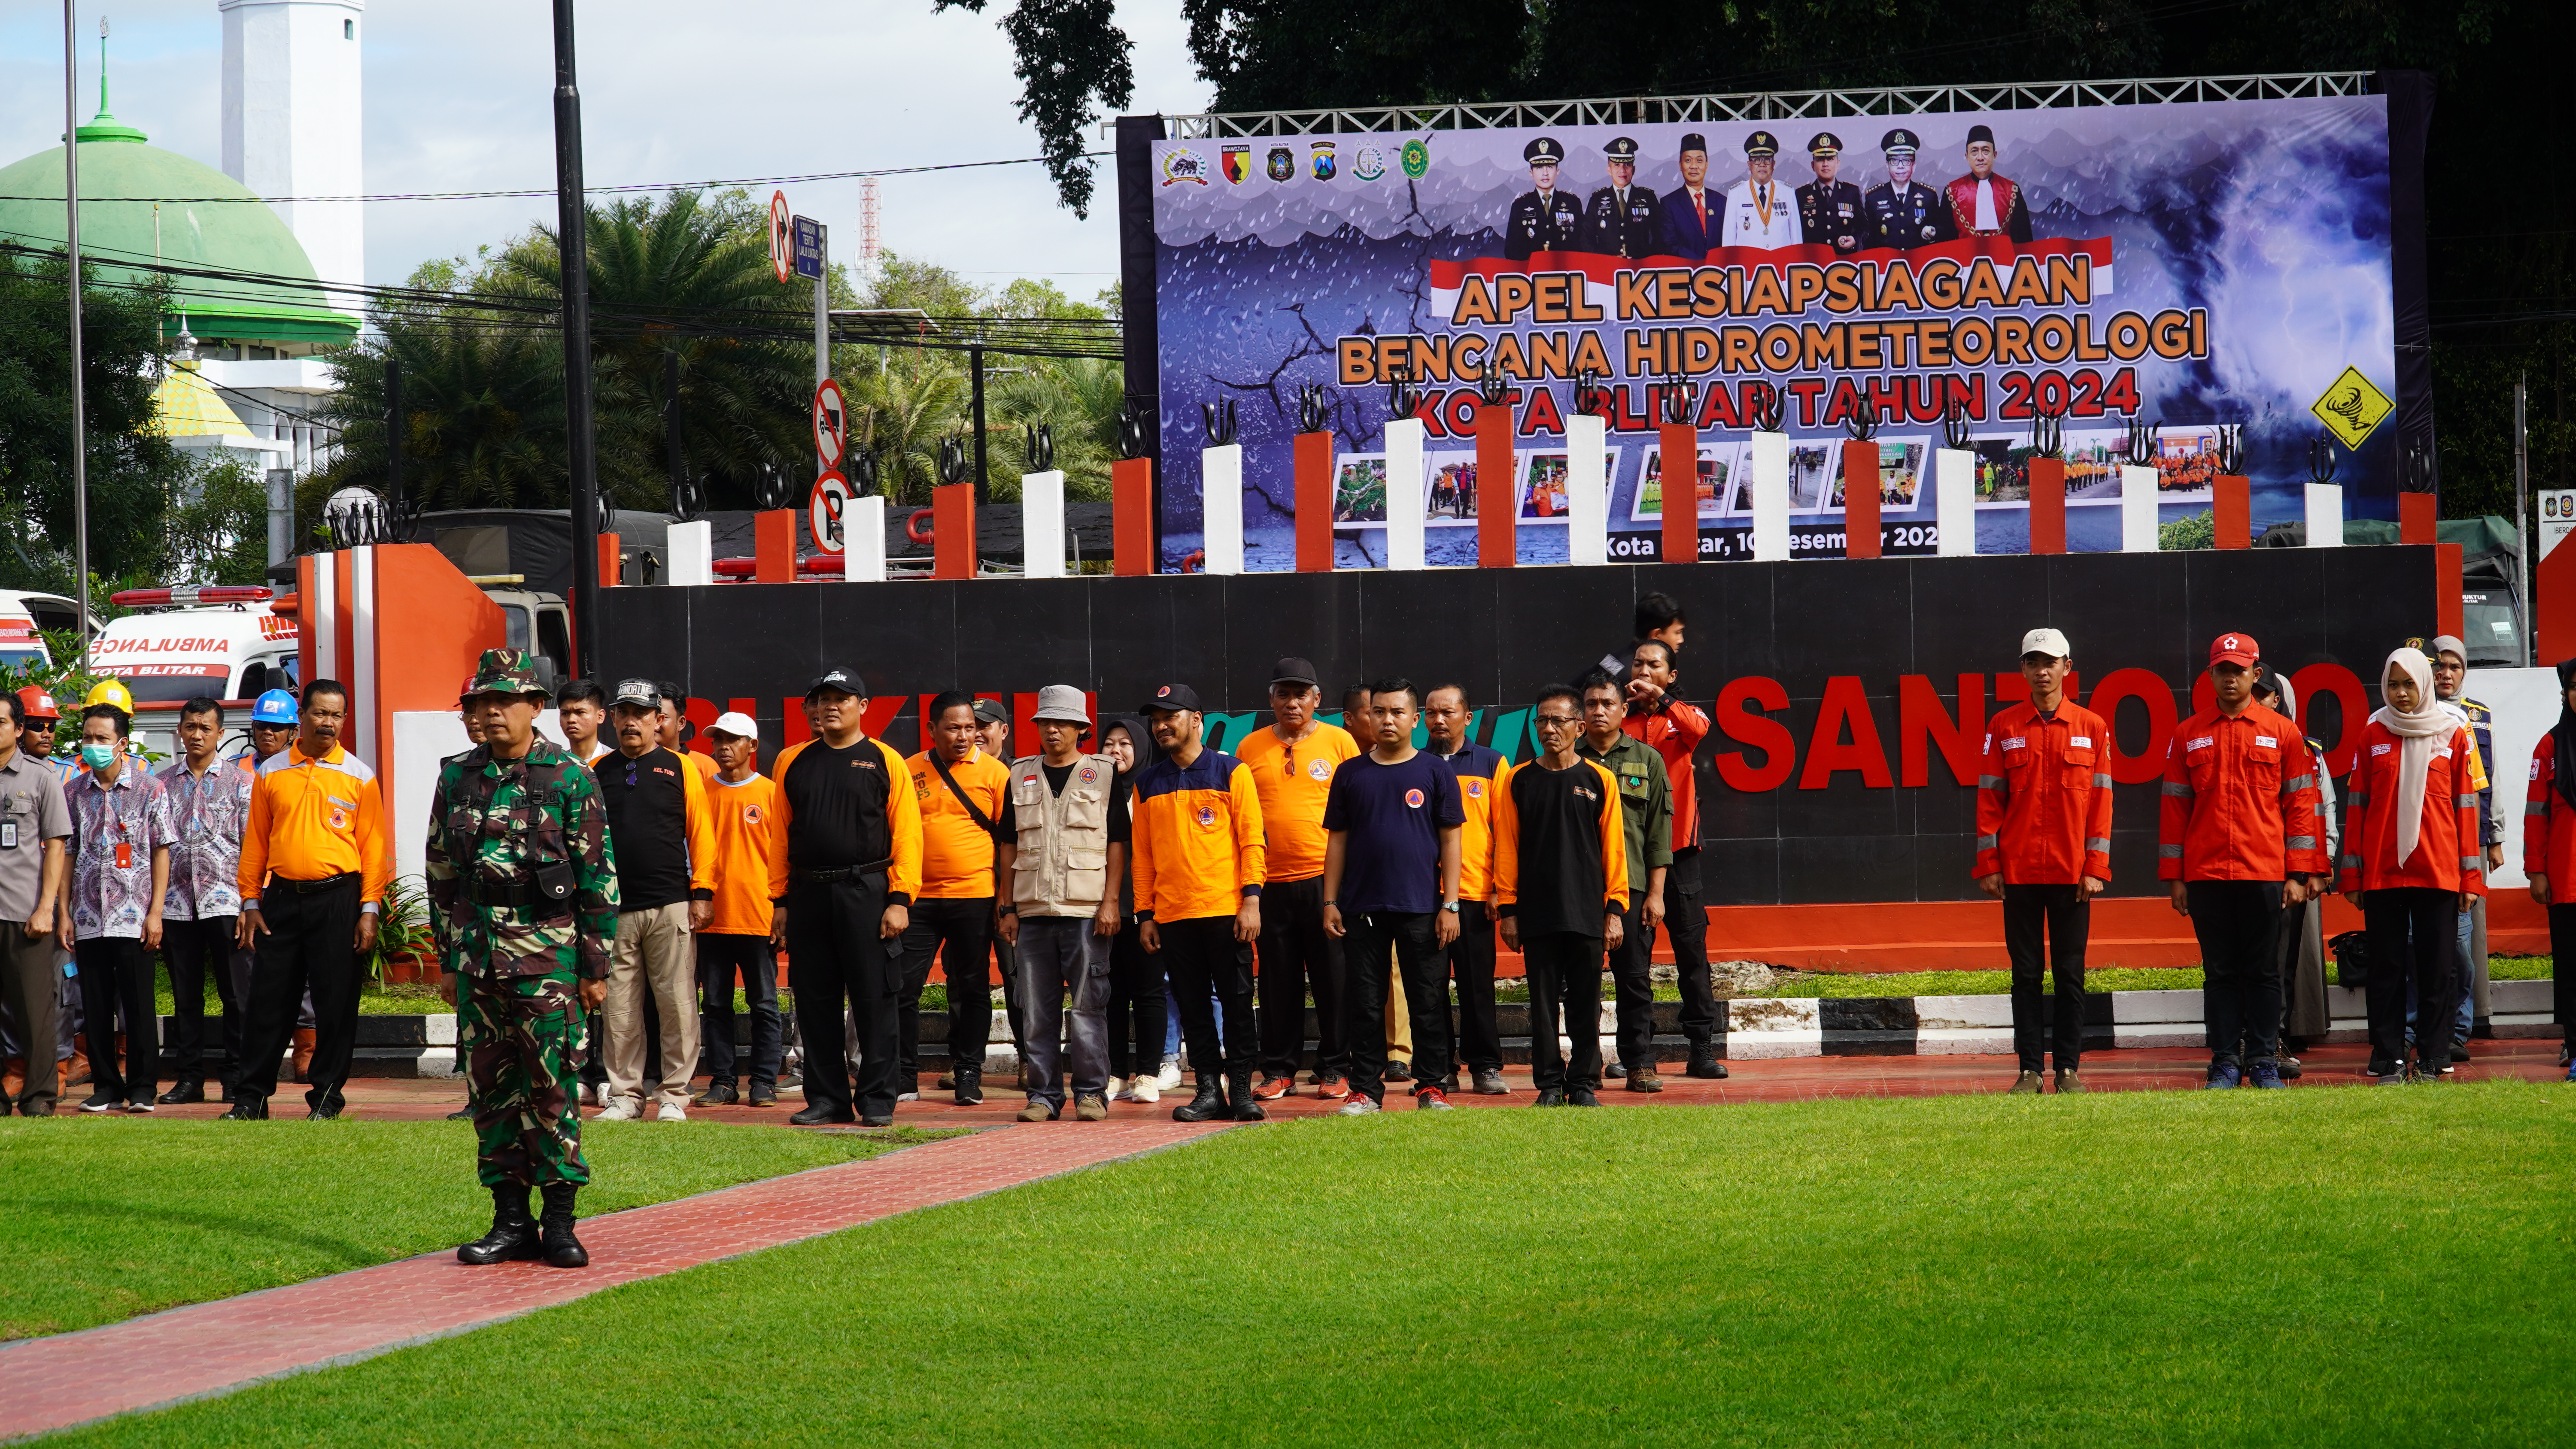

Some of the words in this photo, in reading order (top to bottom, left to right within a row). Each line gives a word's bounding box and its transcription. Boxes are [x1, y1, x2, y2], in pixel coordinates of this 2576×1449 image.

[800, 221, 816, 236] KAWASAN
[803, 234, 814, 247] TERTIB
[799, 245, 808, 257] LALU
[808, 247, 818, 260] LINTAS
[1452, 270, 1604, 325] APEL
[1616, 255, 2091, 322] KESIAPSIAGAAN
[1337, 331, 1614, 387] BENCANA
[1625, 308, 2206, 376] HIDROMETEOROLOGI
[1788, 373, 1986, 426] TAHUN
[1999, 367, 2142, 421] 2024
[825, 490, 843, 540] P
[1894, 526, 1938, 547] 202
[90, 667, 133, 676] KOTA
[138, 666, 207, 675] BLITAR
[1715, 663, 2370, 792] SANOO
